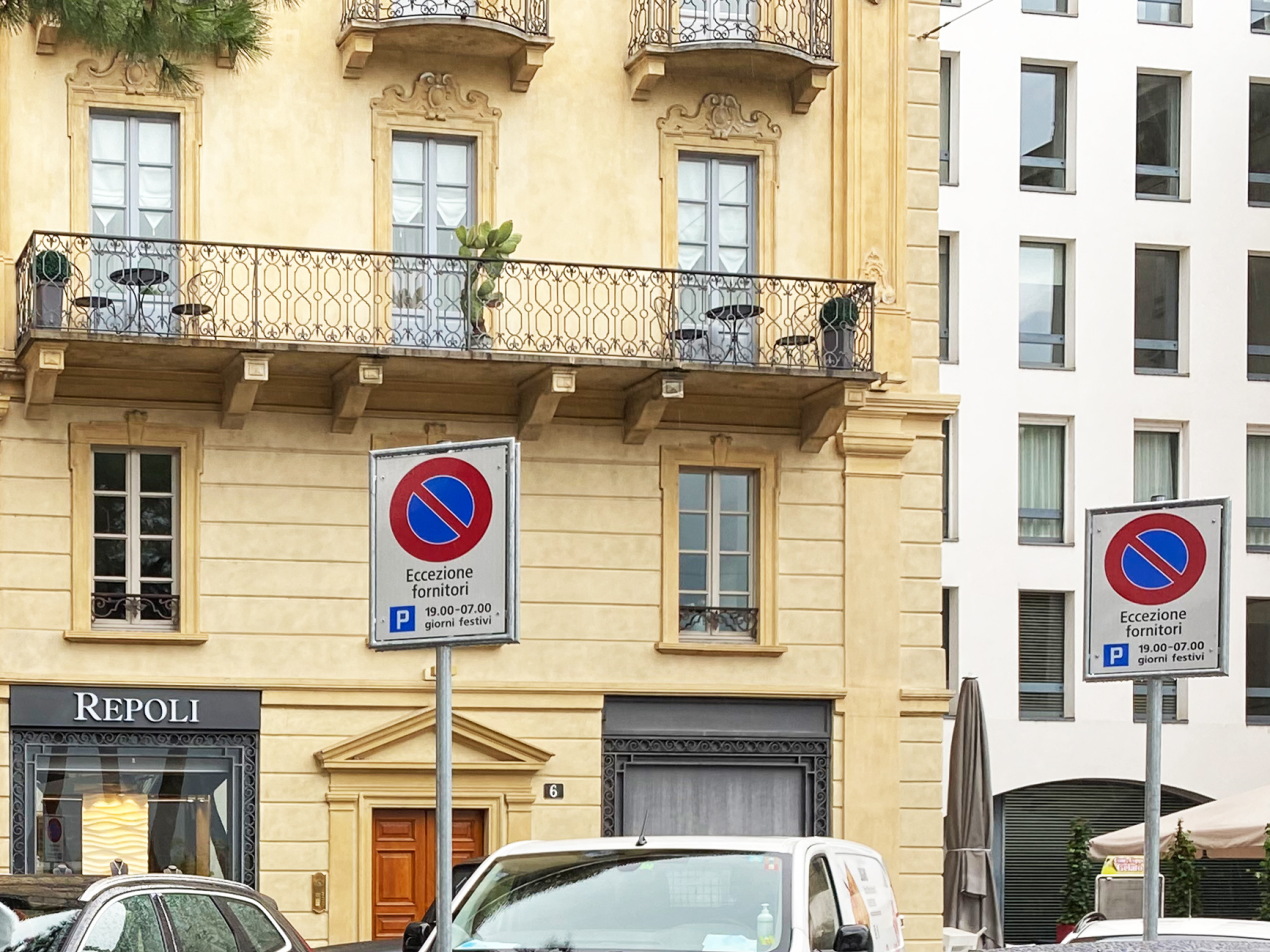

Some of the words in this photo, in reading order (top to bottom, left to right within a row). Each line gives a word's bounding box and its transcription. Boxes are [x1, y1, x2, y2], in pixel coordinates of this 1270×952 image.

[406, 566, 473, 582] Eccezione
[412, 581, 469, 599] fornitori
[397, 610, 409, 630] P
[425, 603, 492, 617] 19.00-07.00
[425, 618, 455, 631] giorni
[459, 615, 492, 627] festivi
[1121, 609, 1187, 623] Eccezione
[1126, 622, 1182, 638] fornitori
[1110, 647, 1123, 665] P
[1139, 641, 1204, 653] 19.00-07.00
[1138, 655, 1167, 666] giorni
[1172, 652, 1204, 662] festivi
[73, 691, 200, 723] REPOLI
[549, 784, 558, 798] 6
